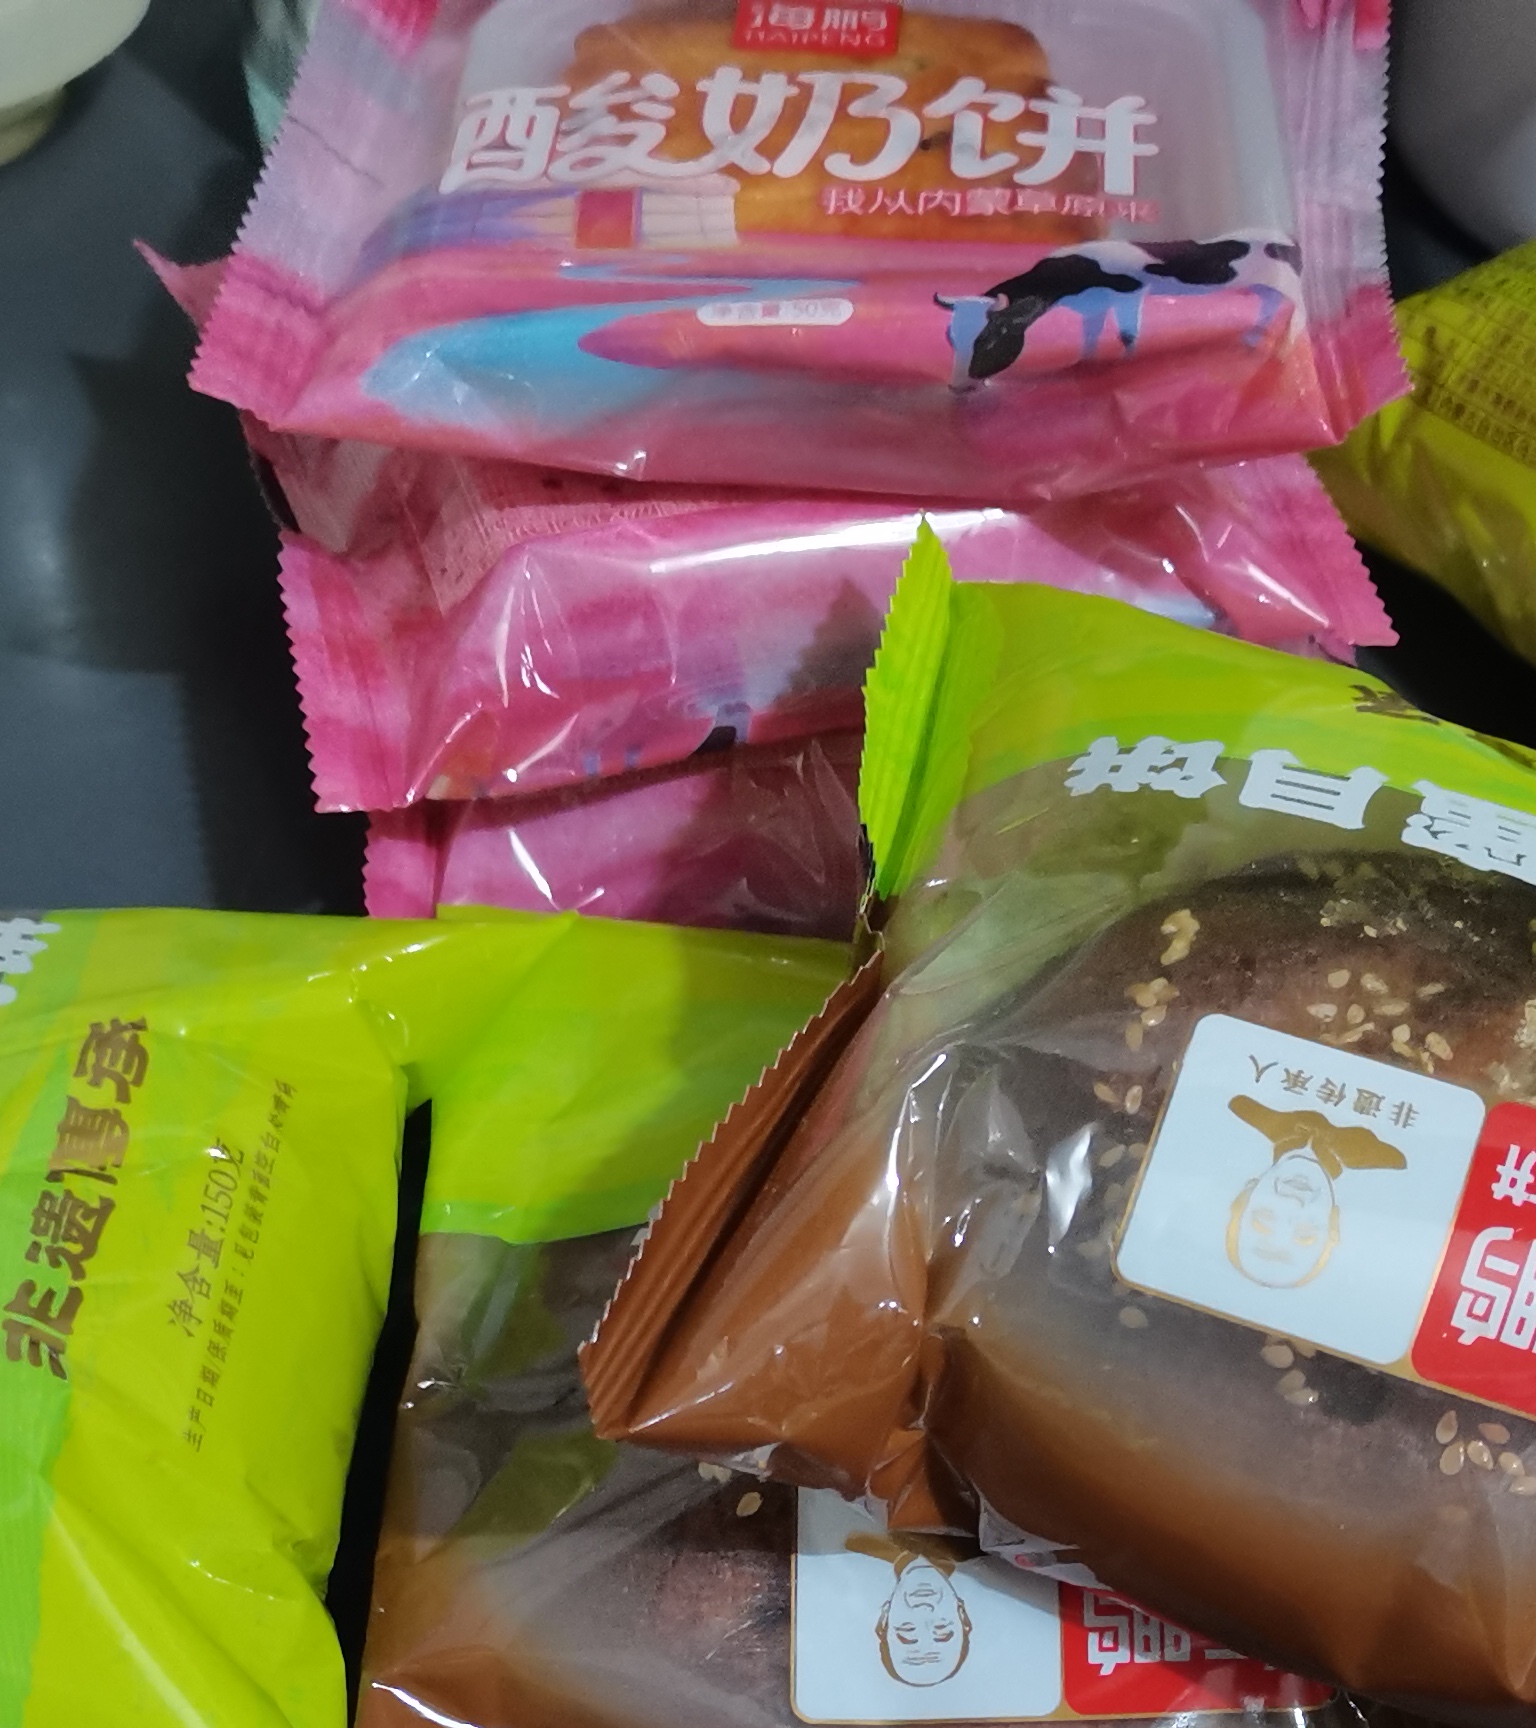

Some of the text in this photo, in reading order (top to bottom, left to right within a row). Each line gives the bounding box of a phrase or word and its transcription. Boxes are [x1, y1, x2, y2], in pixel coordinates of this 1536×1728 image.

[440, 65, 1160, 197] 酸奶饼
[1248, 1053, 1420, 1131] 非遗传承人
